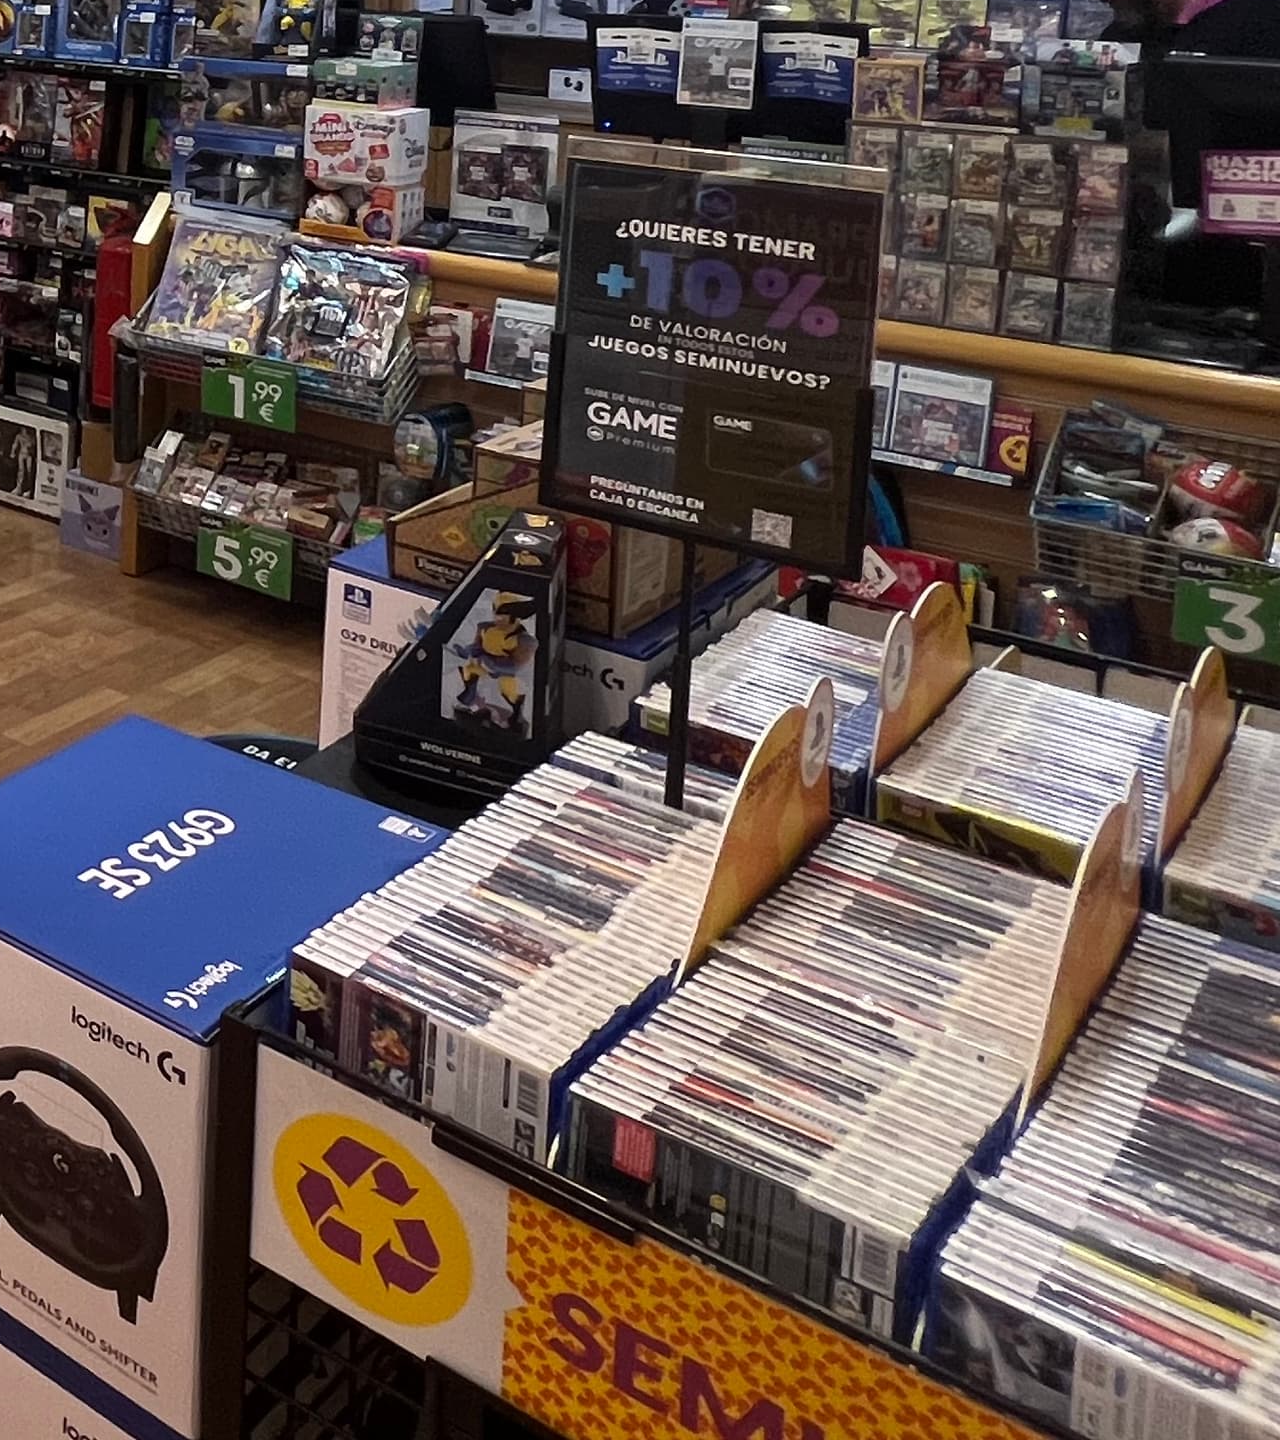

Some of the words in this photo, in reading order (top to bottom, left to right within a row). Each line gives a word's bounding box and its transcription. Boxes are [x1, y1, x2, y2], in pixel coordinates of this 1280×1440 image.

[615, 219, 728, 249] ¿QUIERES
[734, 233, 816, 261] TENER
[596, 248, 839, 338] +10%
[630, 314, 653, 331] DE
[658, 318, 788, 354] VALORACIÓN
[588, 334, 669, 361] JUEGOS
[675, 348, 831, 390] SEMINUEVOS?
[587, 402, 677, 440] GAME
[611, 392, 625, 402] DE
[658, 401, 684, 413] CON
[606, 432, 677, 455] Premium
[713, 415, 752, 432] GAME
[590, 489, 624, 506] CAJA
[636, 500, 699, 525] ESCANEA
[686, 498, 704, 511] EN
[1205, 587, 1266, 655] 3
[340, 628, 367, 645] G29
[370, 639, 408, 657] DRIV
[420, 741, 482, 765] WOLVERINE
[127, 808, 236, 872] G923
[77, 858, 152, 900] SE
[185, 959, 243, 996] logitech
[70, 1005, 151, 1065] logitech
[12, 1278, 62, 1322] PEDALS
[65, 1316, 97, 1344] AND
[99, 1338, 158, 1387] SHIFTER
[548, 1292, 825, 1440] SEM
